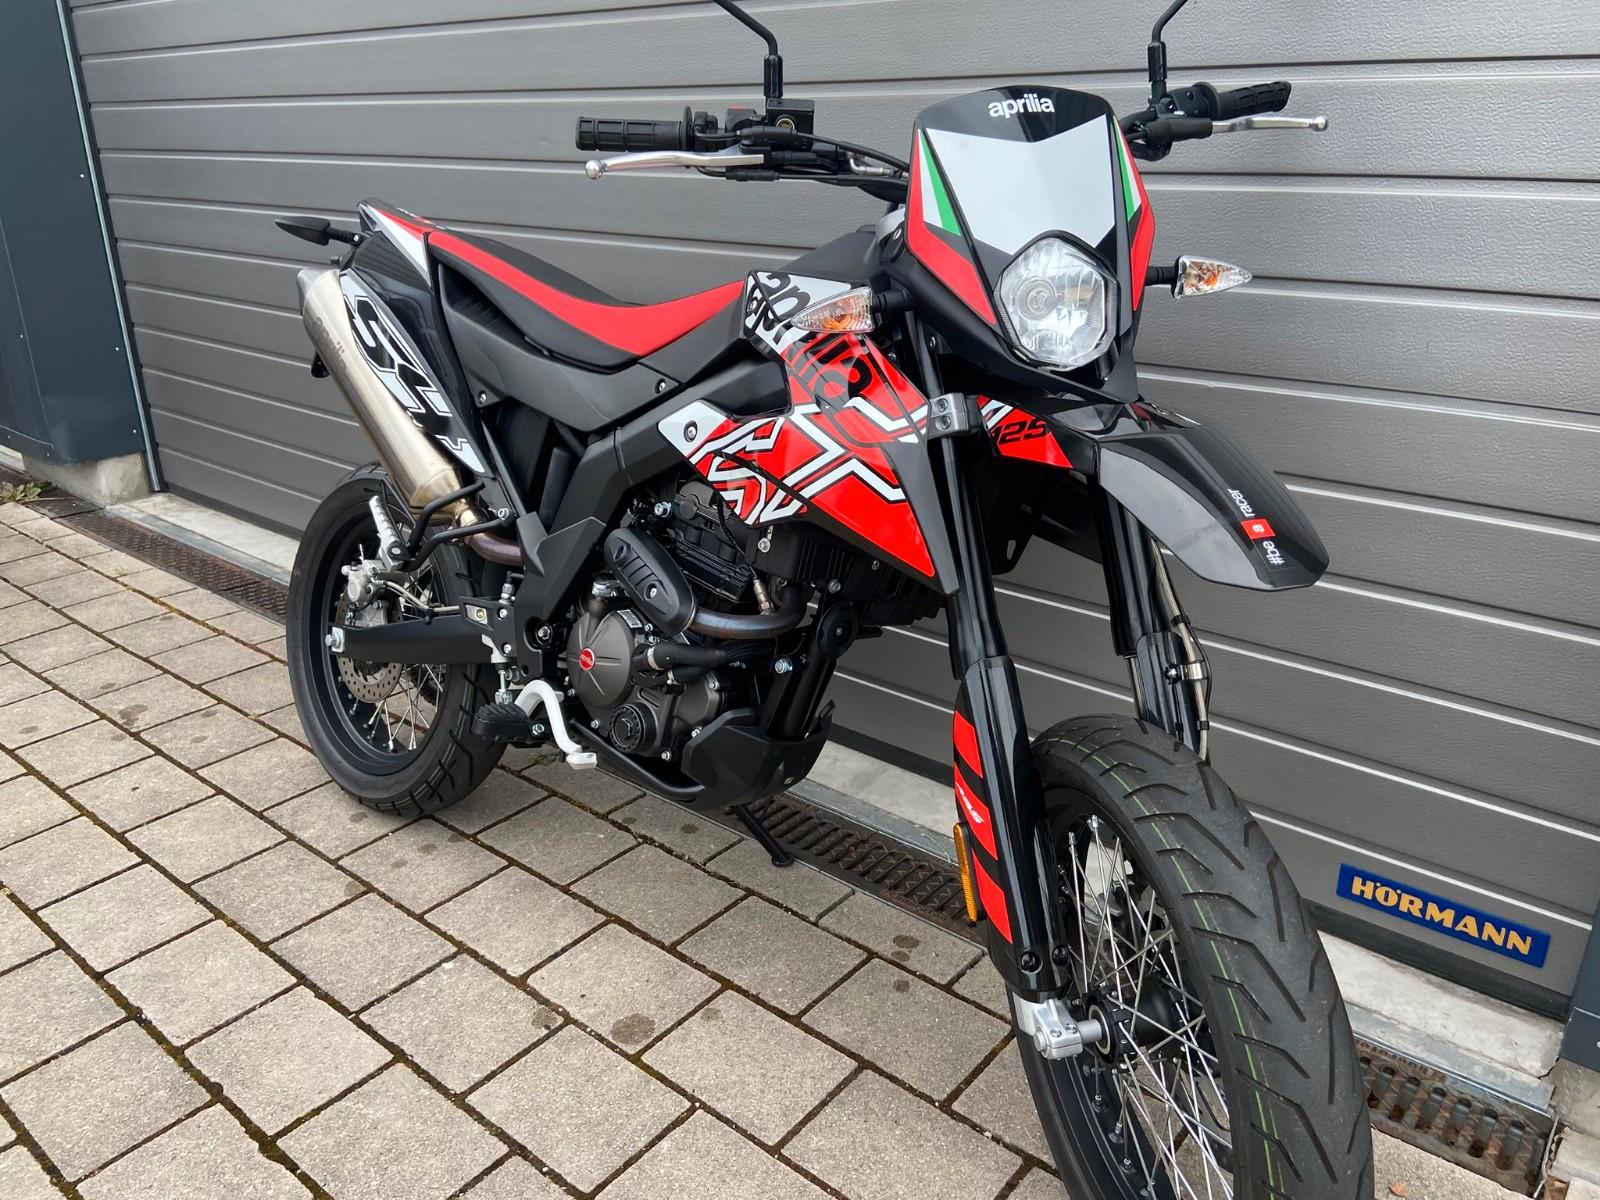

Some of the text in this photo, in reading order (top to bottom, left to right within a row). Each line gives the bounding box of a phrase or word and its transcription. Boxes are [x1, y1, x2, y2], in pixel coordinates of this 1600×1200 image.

[988, 93, 1055, 119] aprilia
[1227, 488, 1255, 518] racer
[1262, 540, 1285, 565] #be
[1351, 876, 1532, 955] HÖRMANN
